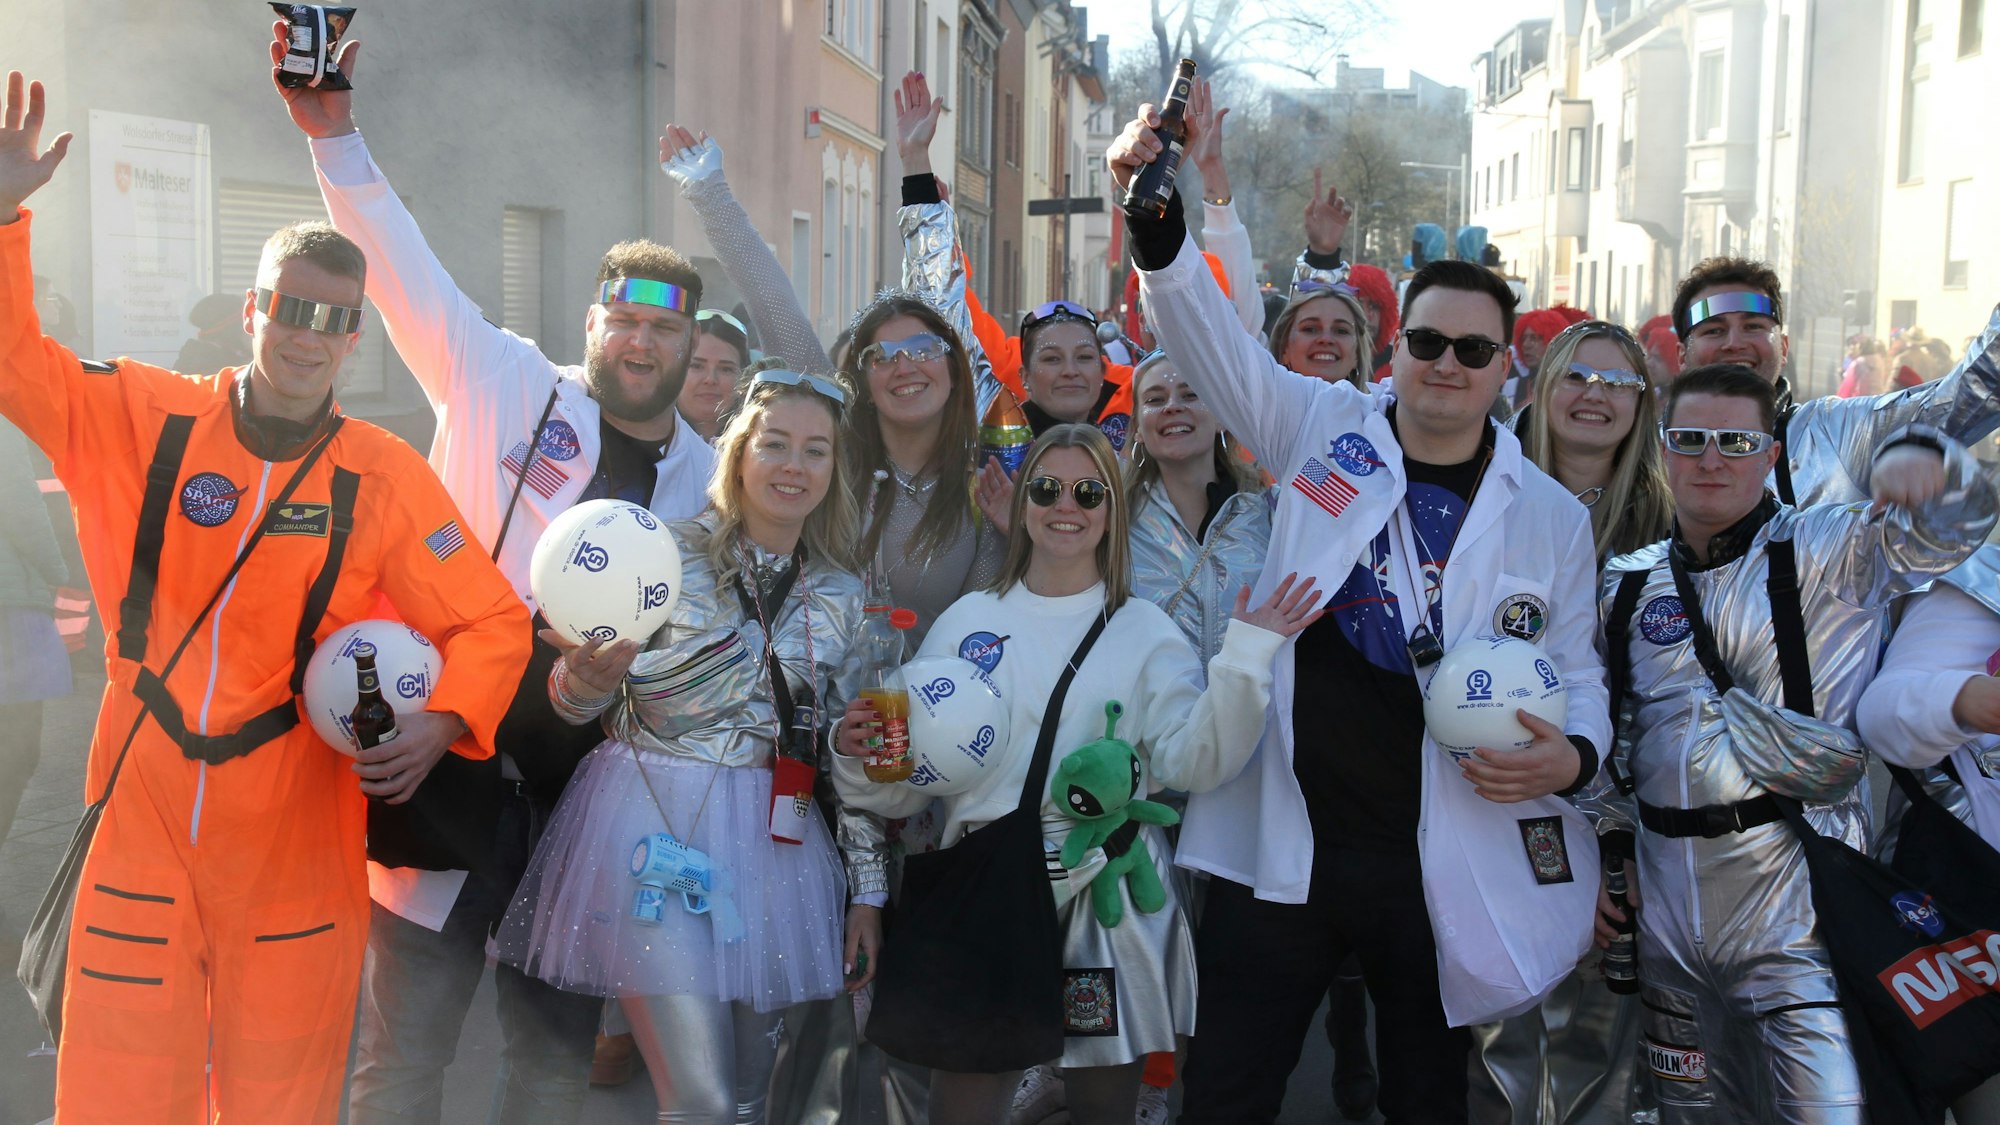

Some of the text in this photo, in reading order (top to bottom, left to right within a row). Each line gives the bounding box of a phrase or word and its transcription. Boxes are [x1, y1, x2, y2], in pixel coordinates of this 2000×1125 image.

[121, 124, 165, 142] Wolsdorfer
[134, 167, 191, 193] Malteser
[541, 427, 576, 455] NASA
[1338, 438, 1372, 473] NASA
[183, 486, 235, 512] SPACE
[273, 523, 319, 531] COMMANDER
[1507, 595, 1546, 613] APOLLO
[1643, 613, 1690, 628] SPACE
[963, 645, 1001, 660] NASA
[1457, 702, 1505, 710] www.dr-starck.de
[1650, 1049, 1681, 1073] KÖLN
